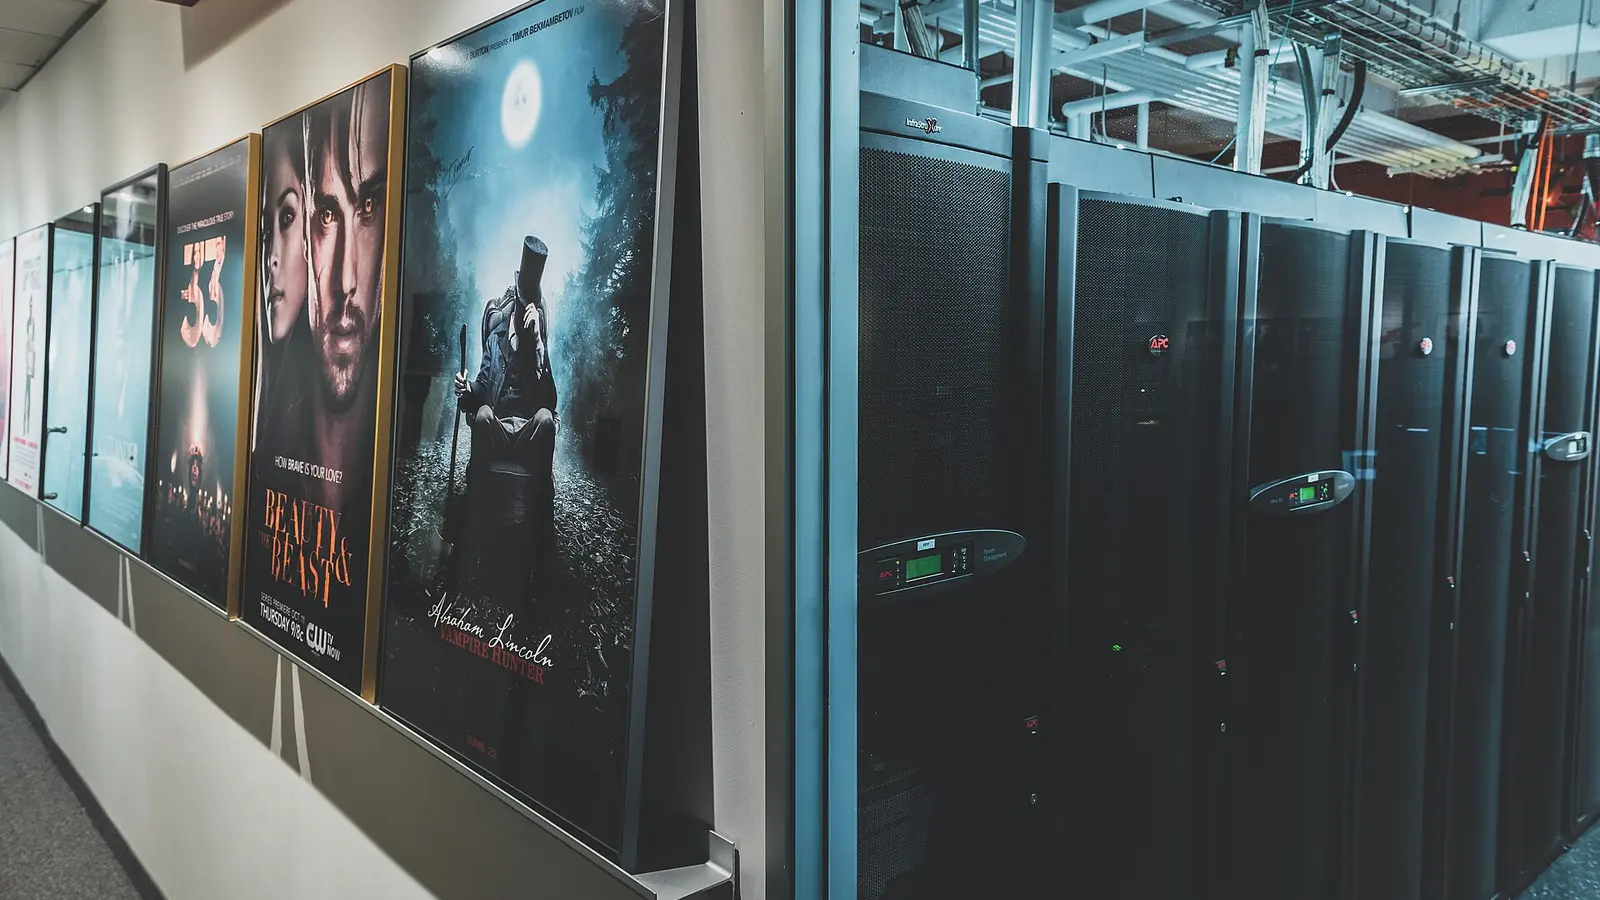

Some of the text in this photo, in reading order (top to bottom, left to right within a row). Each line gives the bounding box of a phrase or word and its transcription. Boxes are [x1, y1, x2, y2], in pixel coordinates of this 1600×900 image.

[470, 45, 490, 60] BURTON
[490, 38, 508, 51] PRESENTS
[512, 28, 530, 42] TIMUR
[530, 8, 574, 35] BEKMAMBETOV
[574, 5, 585, 17] FILM
[180, 235, 226, 348] 33
[1150, 338, 1169, 349] APC
[274, 455, 343, 484] HOW BRAVE IS YOUR LOVE?
[264, 488, 353, 587] BEAUTY &
[271, 532, 335, 608] BEAST
[879, 570, 893, 579] APC
[260, 591, 273, 606] SERIES
[273, 598, 291, 617] PREMIERE
[291, 609, 300, 621] OCT
[260, 602, 304, 642] THURSDAY 9/8c
[306, 622, 327, 655] CW
[327, 632, 334, 645] TV
[428, 592, 554, 667] Abraham Lincoln
[327, 644, 341, 661] NOW
[440, 621, 544, 685] VAMPIRE HUNTER
